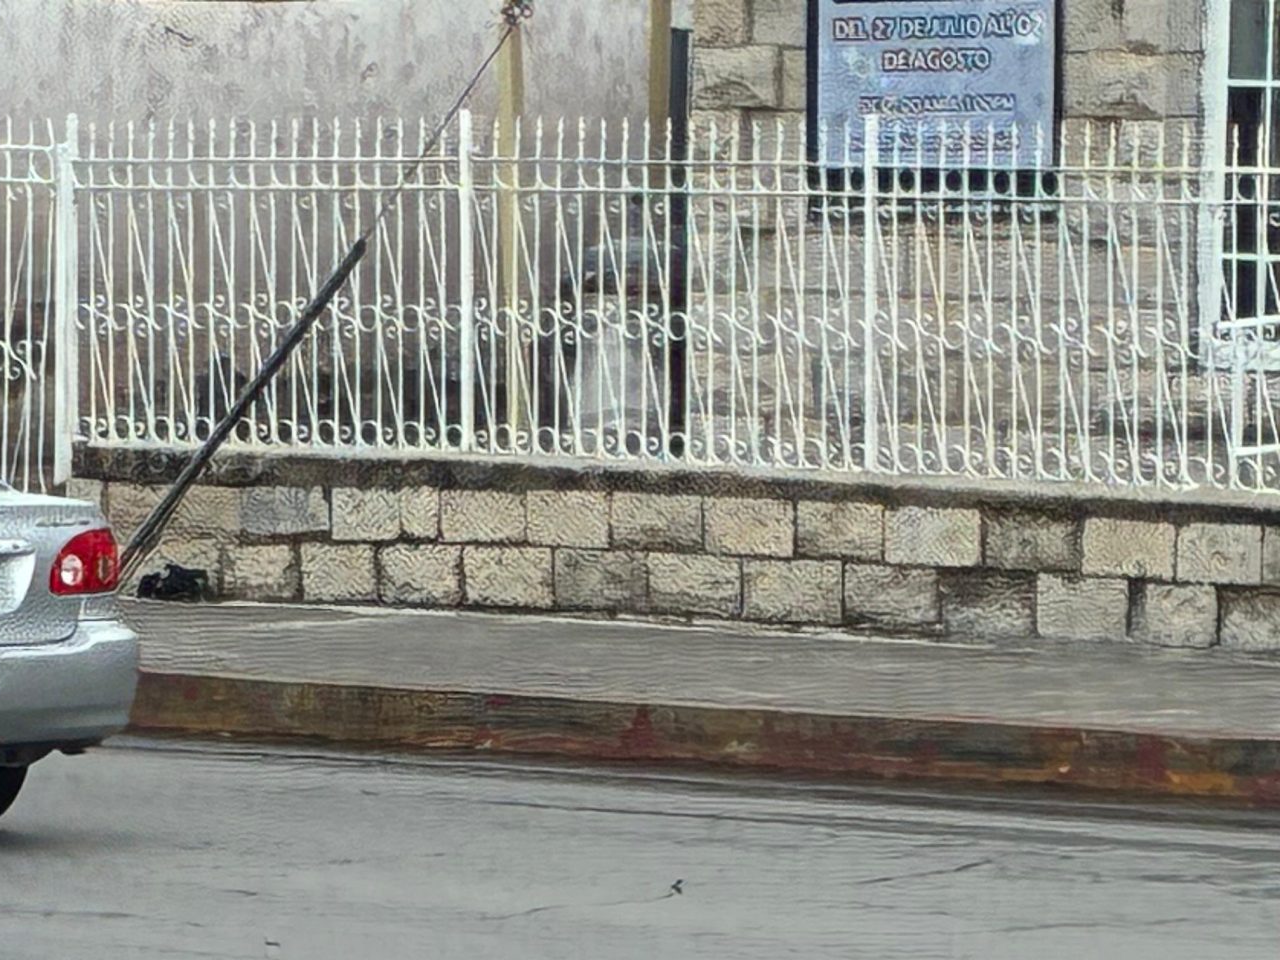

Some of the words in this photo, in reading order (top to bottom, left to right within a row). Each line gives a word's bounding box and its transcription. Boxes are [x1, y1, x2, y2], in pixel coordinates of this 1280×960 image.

[833, 17, 868, 40] DEL
[872, 16, 897, 40] 27
[899, 16, 928, 39] DE
[928, 15, 983, 38] JULIO
[882, 50, 911, 72] DE
[911, 48, 992, 72] AGOSTO
